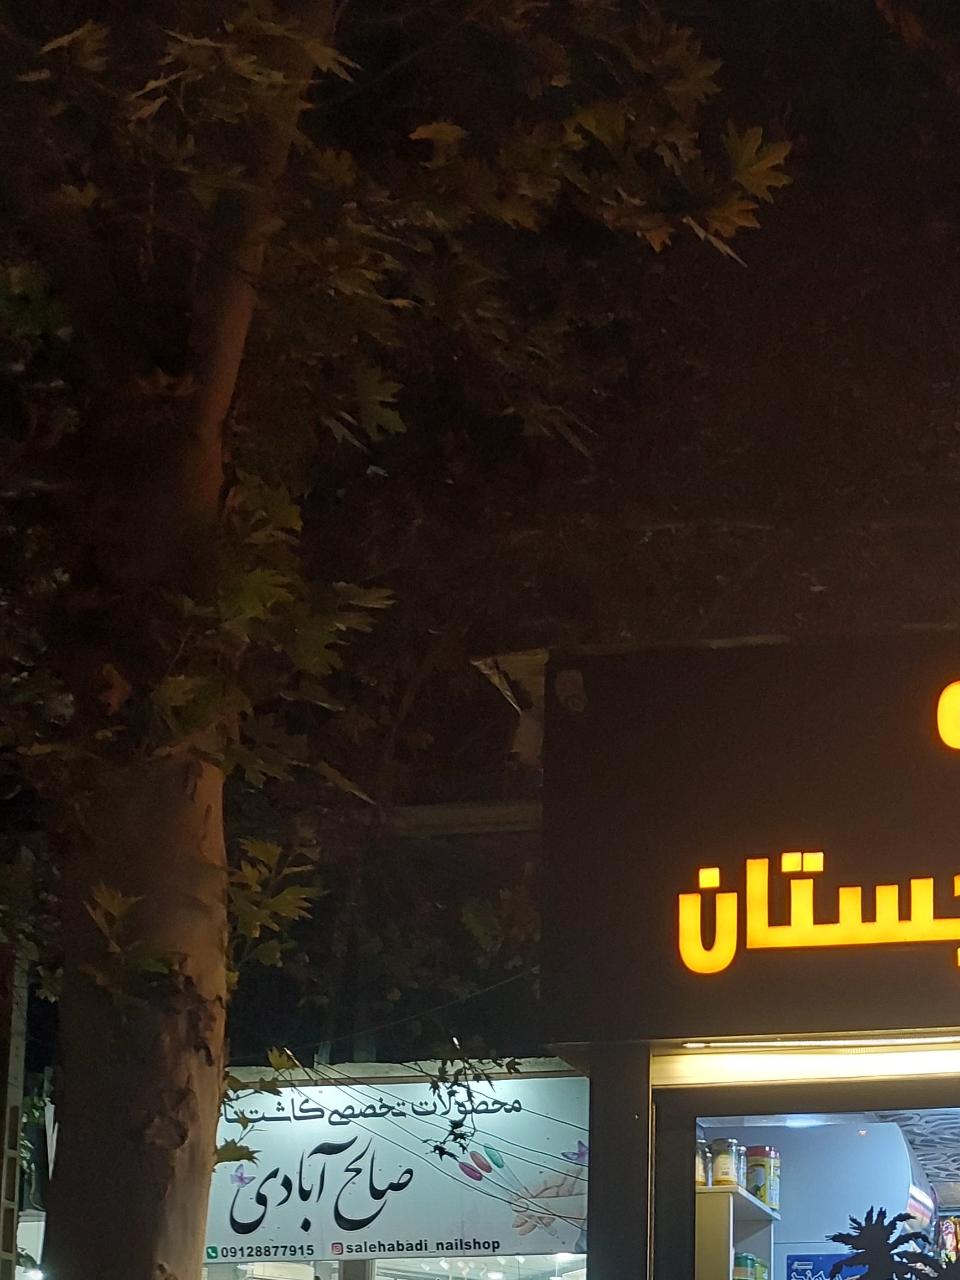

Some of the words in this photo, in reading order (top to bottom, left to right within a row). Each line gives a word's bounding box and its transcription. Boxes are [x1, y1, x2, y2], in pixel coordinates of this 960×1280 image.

[246, 1098, 324, 1122] کاشت
[328, 1098, 407, 1126] تخصصی
[411, 1093, 522, 1123] محصولات
[229, 1136, 358, 1235] آبادی
[334, 1137, 414, 1231] صالح
[221, 1244, 315, 1258] 09128877915
[346, 1238, 500, 1254] salehabadi_nailshop
